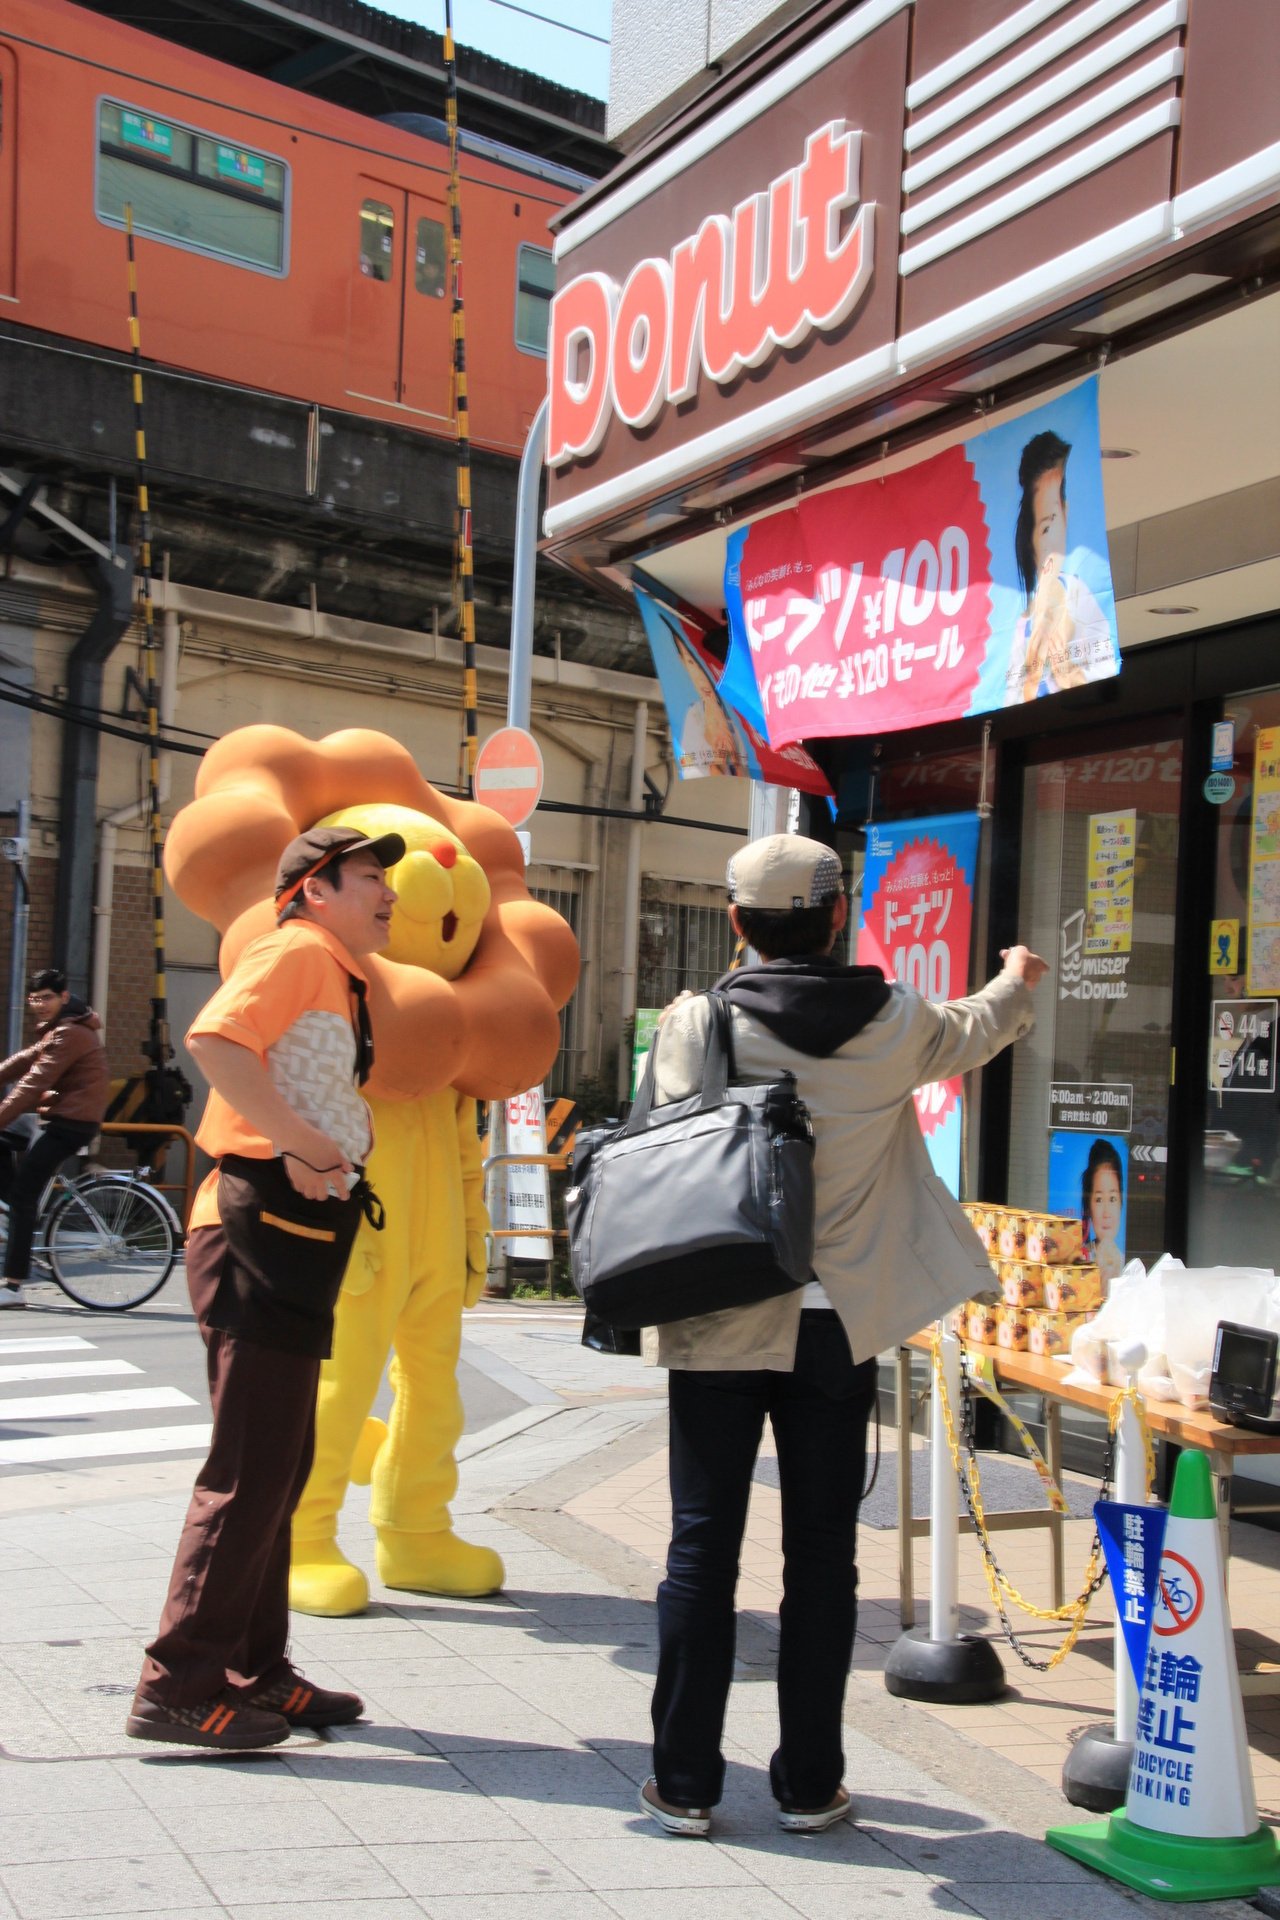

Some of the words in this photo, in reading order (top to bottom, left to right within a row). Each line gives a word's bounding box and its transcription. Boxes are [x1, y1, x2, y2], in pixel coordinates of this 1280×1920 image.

[545, 118, 876, 466] Donut
[884, 888, 953, 944] ドーナツ
[1081, 980, 1129, 1000] Donut
[1123, 1512, 1146, 1626] 駐輪禁止
[1138, 1750, 1194, 1782] BICYCLE
[1130, 1772, 1191, 1807] ARKING
